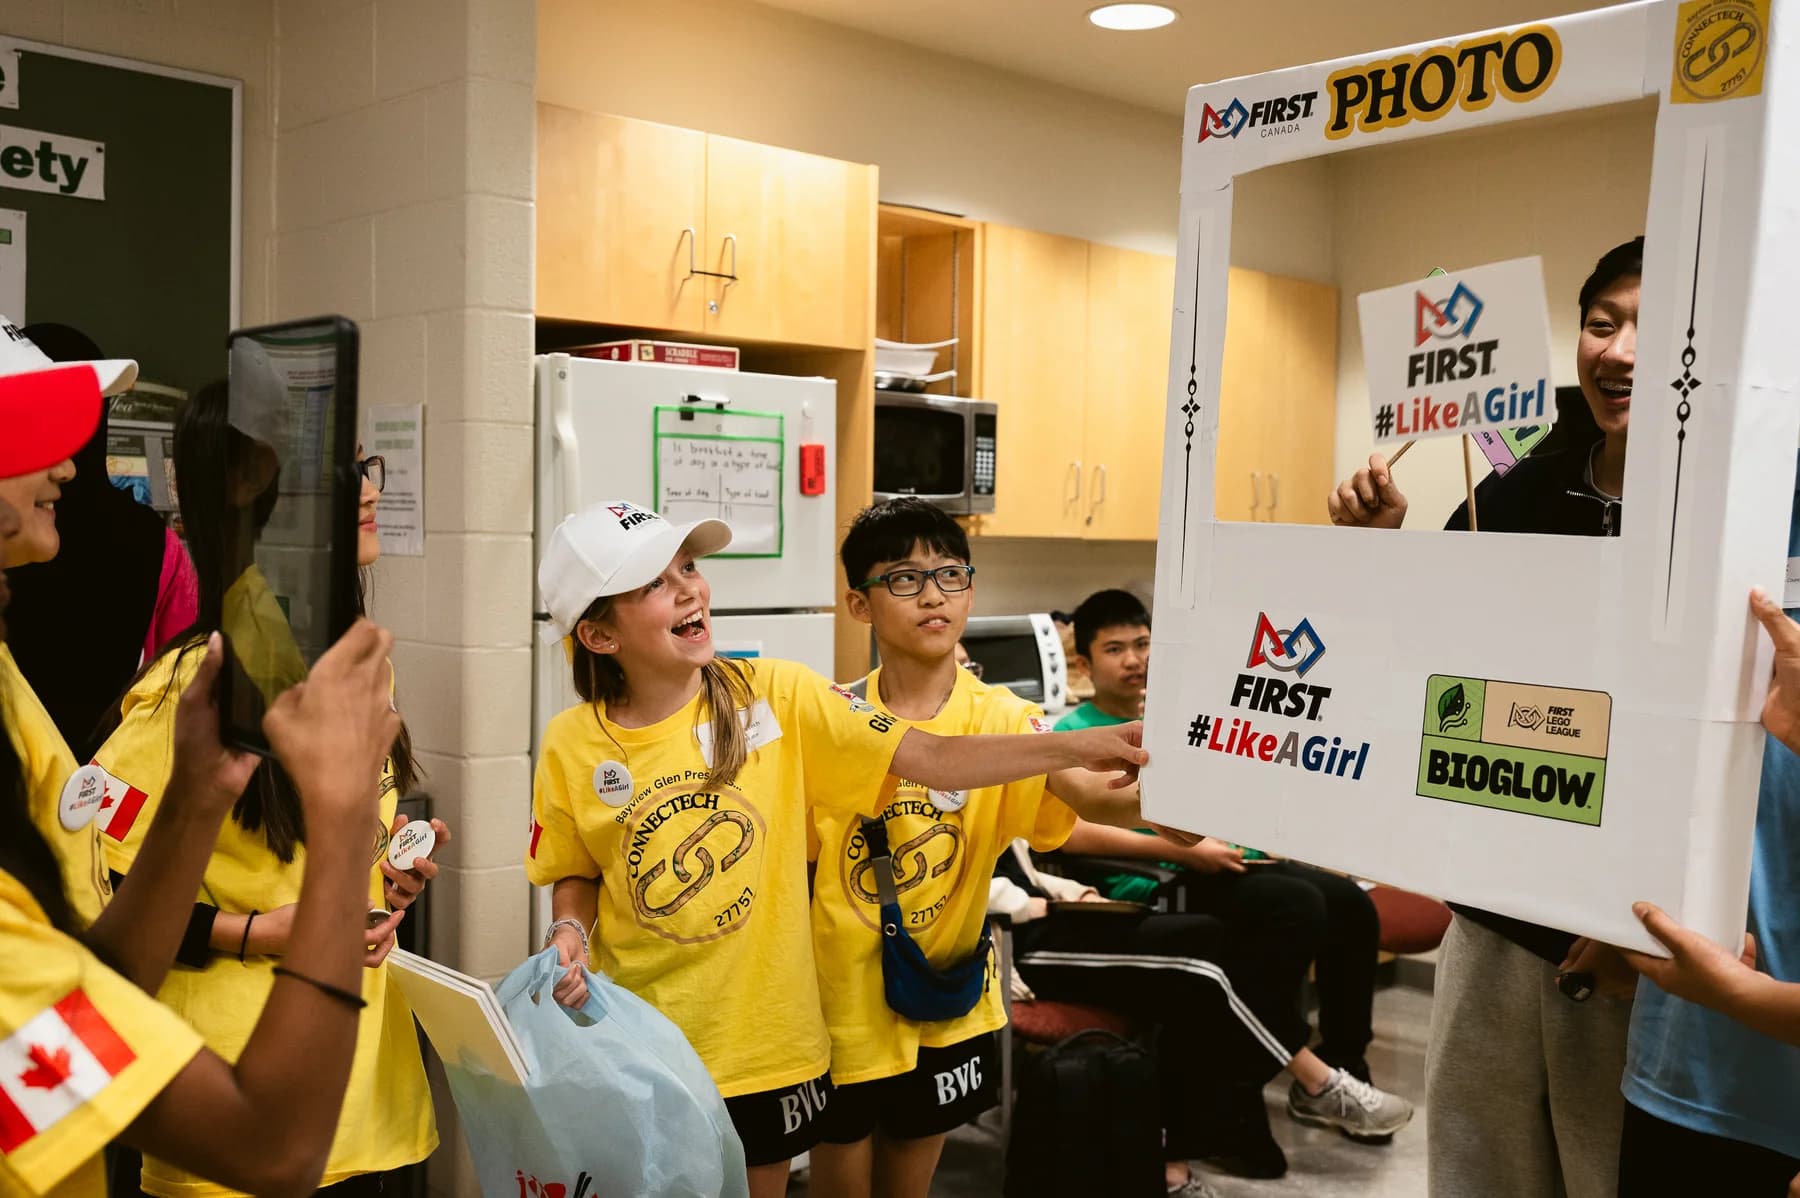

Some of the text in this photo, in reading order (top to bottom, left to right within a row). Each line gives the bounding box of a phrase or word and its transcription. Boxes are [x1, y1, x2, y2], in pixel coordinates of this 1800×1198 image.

[1682, 10, 1744, 58] CONNECTECH
[1331, 32, 1554, 131] PHOTO
[1720, 68, 1746, 92] 27757
[1248, 91, 1318, 128] FIRST
[1260, 123, 1300, 138] CANADA
[1407, 339, 1499, 388] FIRST
[1375, 378, 1546, 438] #LikeAGirl
[1230, 674, 1332, 721] FIRST
[1547, 706, 1575, 717] FIRST
[1547, 716, 1571, 726] LEGO
[1188, 714, 1370, 780] #LikeAGirl
[1546, 726, 1582, 738] LEAGUE
[615, 770, 742, 825] Bayview Glen Press...
[1427, 749, 1596, 809] BIOGLOW
[394, 832, 428, 860] #LikeAGirl
[399, 832, 417, 849] FIRST
[628, 792, 720, 879] CONNECTECH
[847, 800, 943, 860] COECTECH
[714, 886, 753, 927] 27757
[911, 895, 948, 924] 27757
[933, 1056, 982, 1106] BVG
